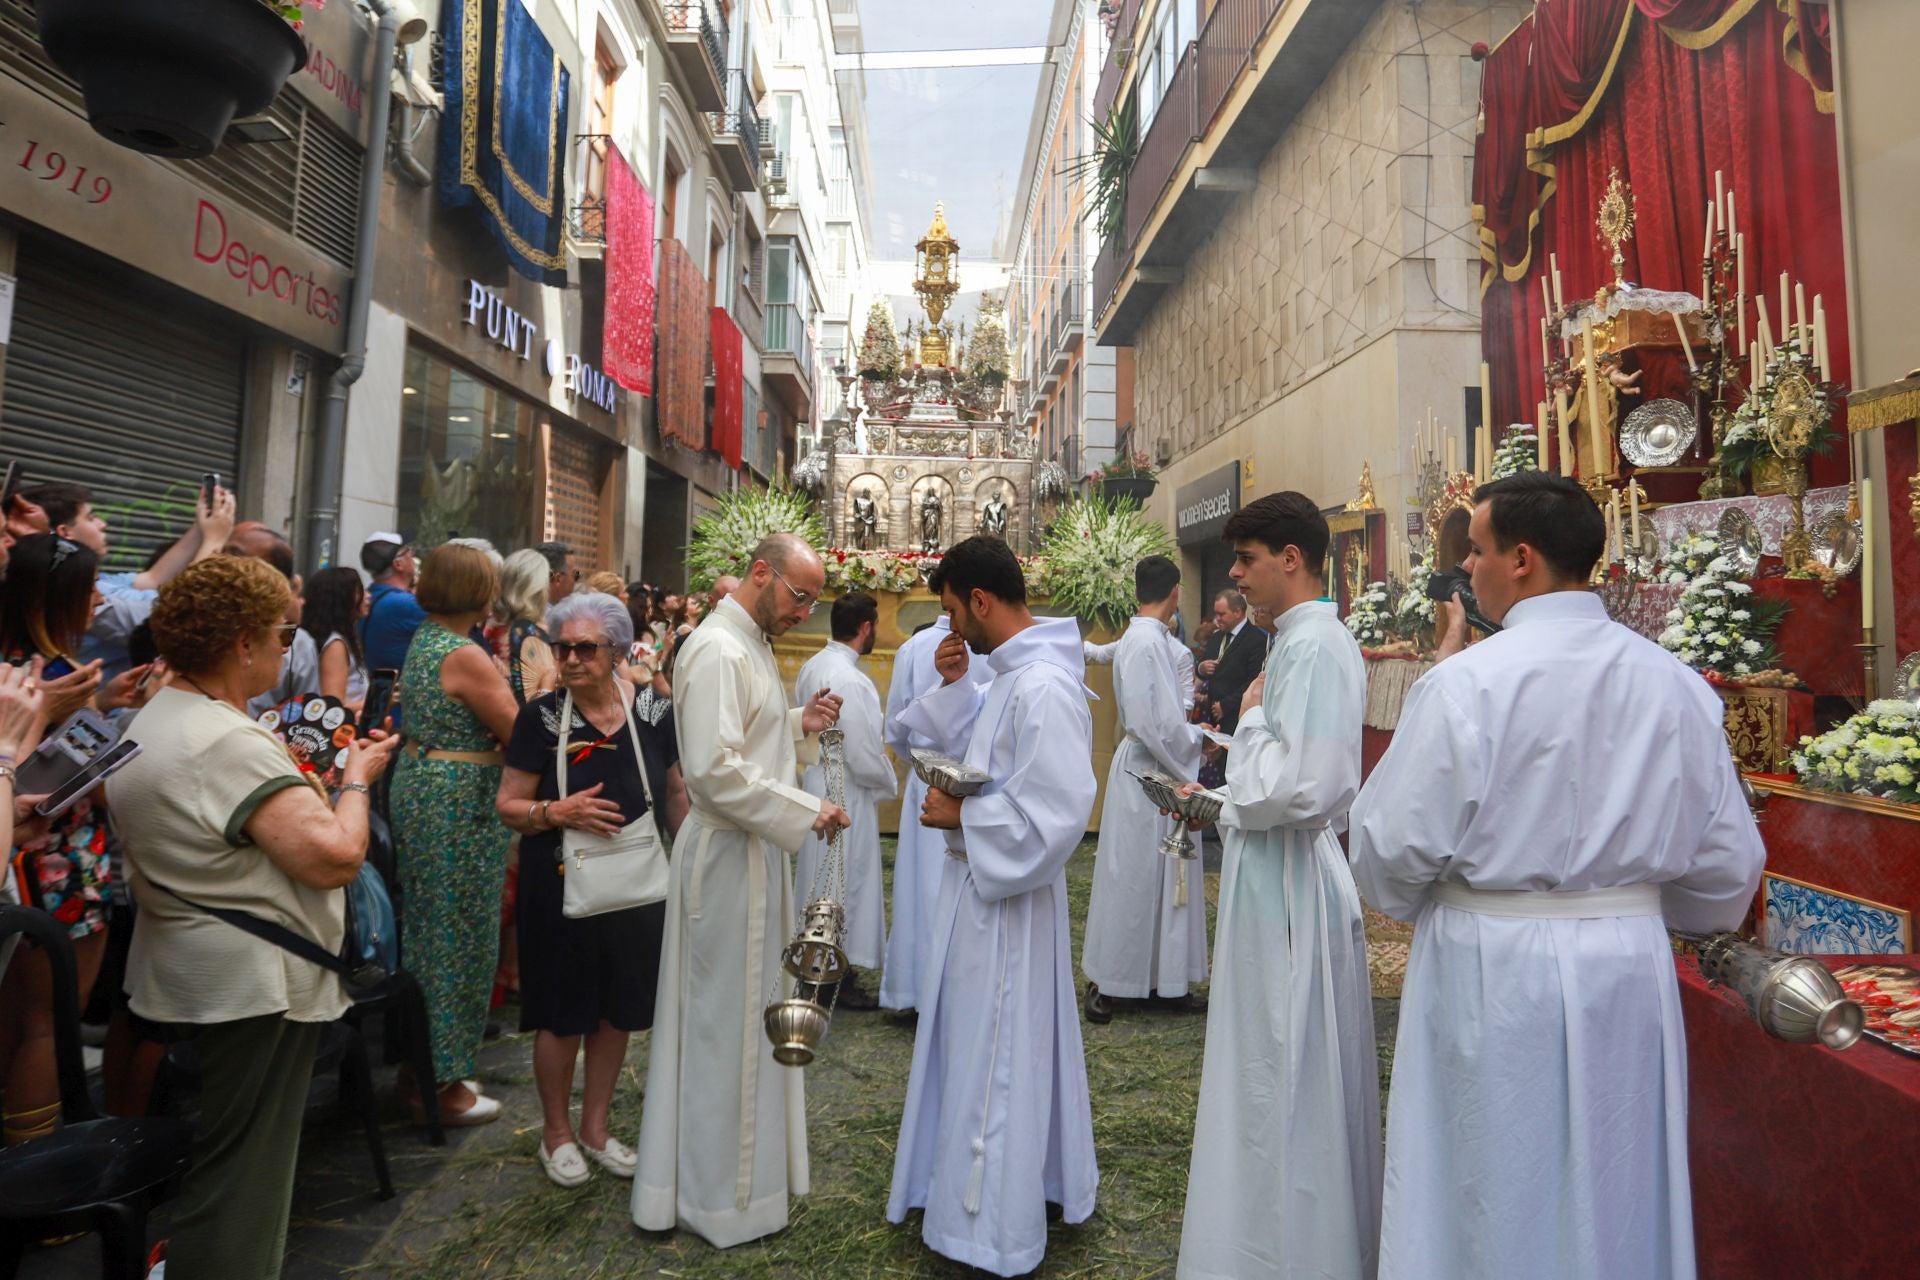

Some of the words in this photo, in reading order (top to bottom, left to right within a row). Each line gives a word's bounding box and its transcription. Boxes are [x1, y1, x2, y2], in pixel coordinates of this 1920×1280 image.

[16, 140, 113, 204] 1919
[194, 199, 341, 326] Deportes
[464, 279, 537, 361] PUNT
[569, 353, 616, 414] ROMA
